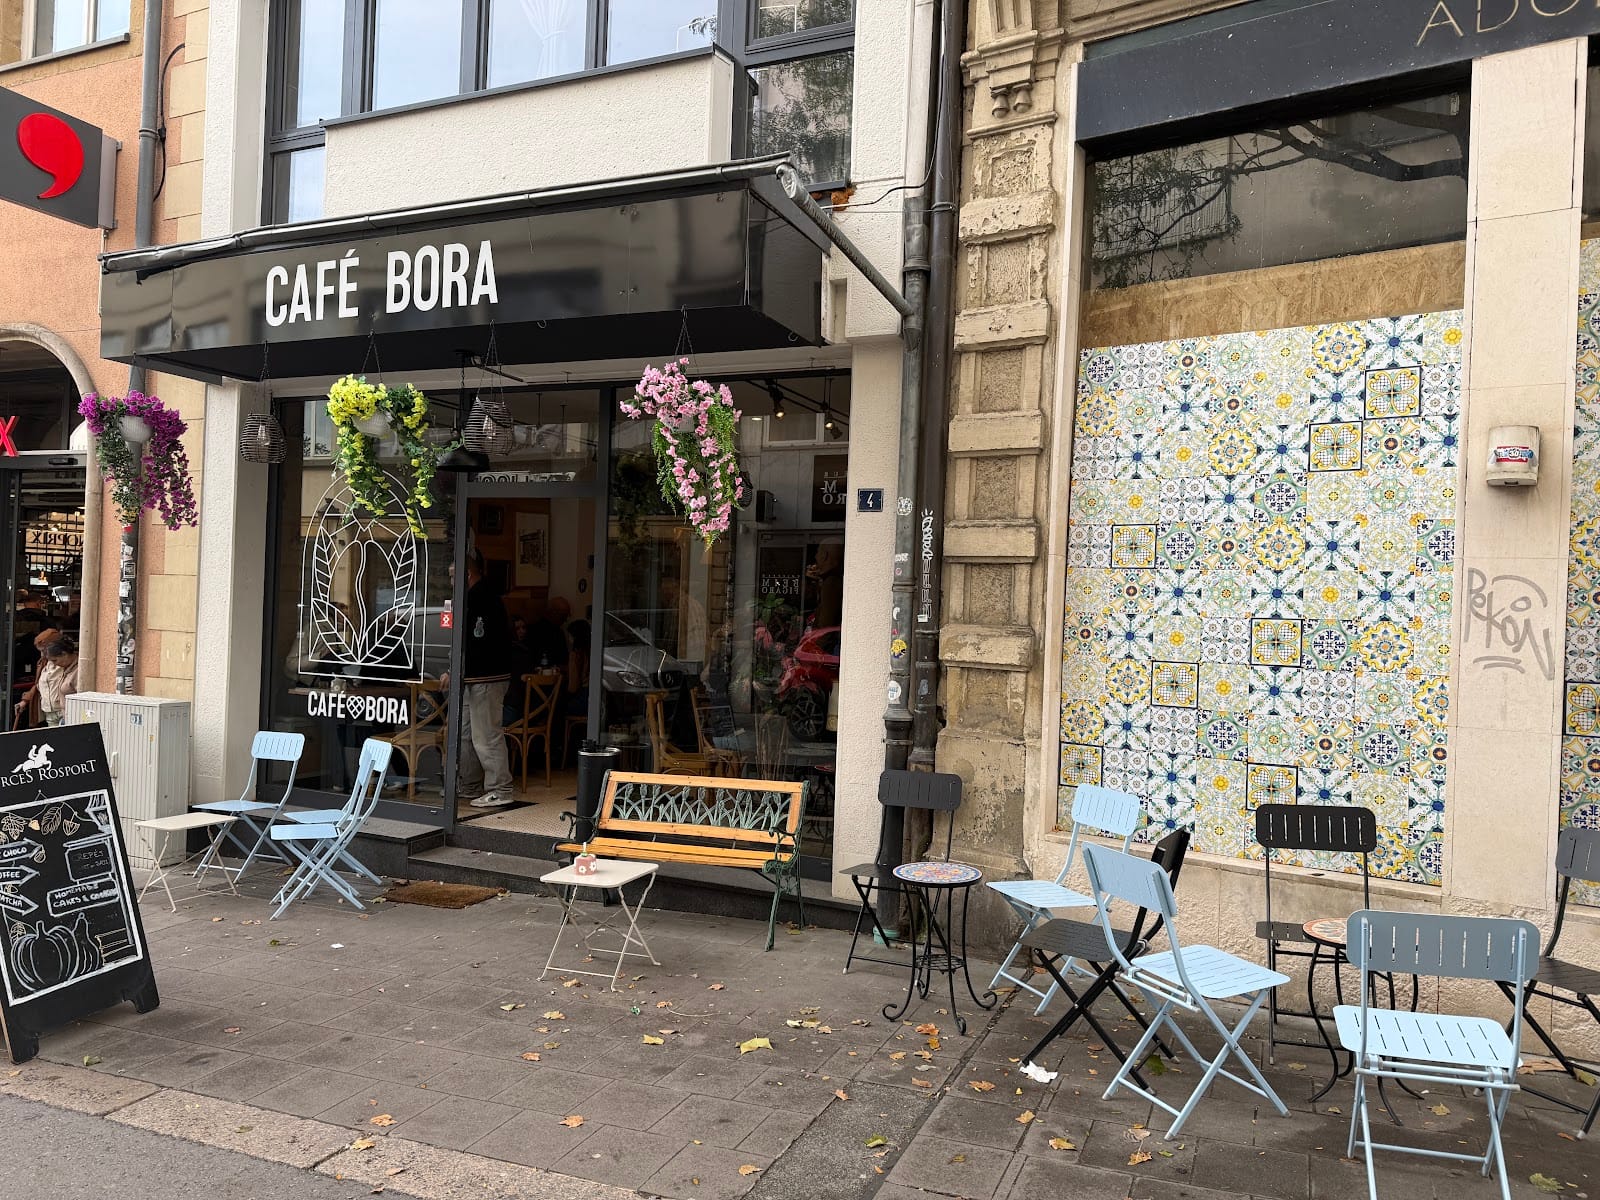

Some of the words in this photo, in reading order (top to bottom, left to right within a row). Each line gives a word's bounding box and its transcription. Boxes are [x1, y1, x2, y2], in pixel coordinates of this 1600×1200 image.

[265, 249, 360, 326] CAFÉ
[386, 240, 498, 313] BORA
[866, 493, 874, 507] 4
[308, 691, 346, 718] CAFÉ
[365, 696, 409, 725] BORA
[1, 770, 34, 787] RCES
[3, 847, 27, 857] CHOCO
[53, 896, 81, 908] CAKES
